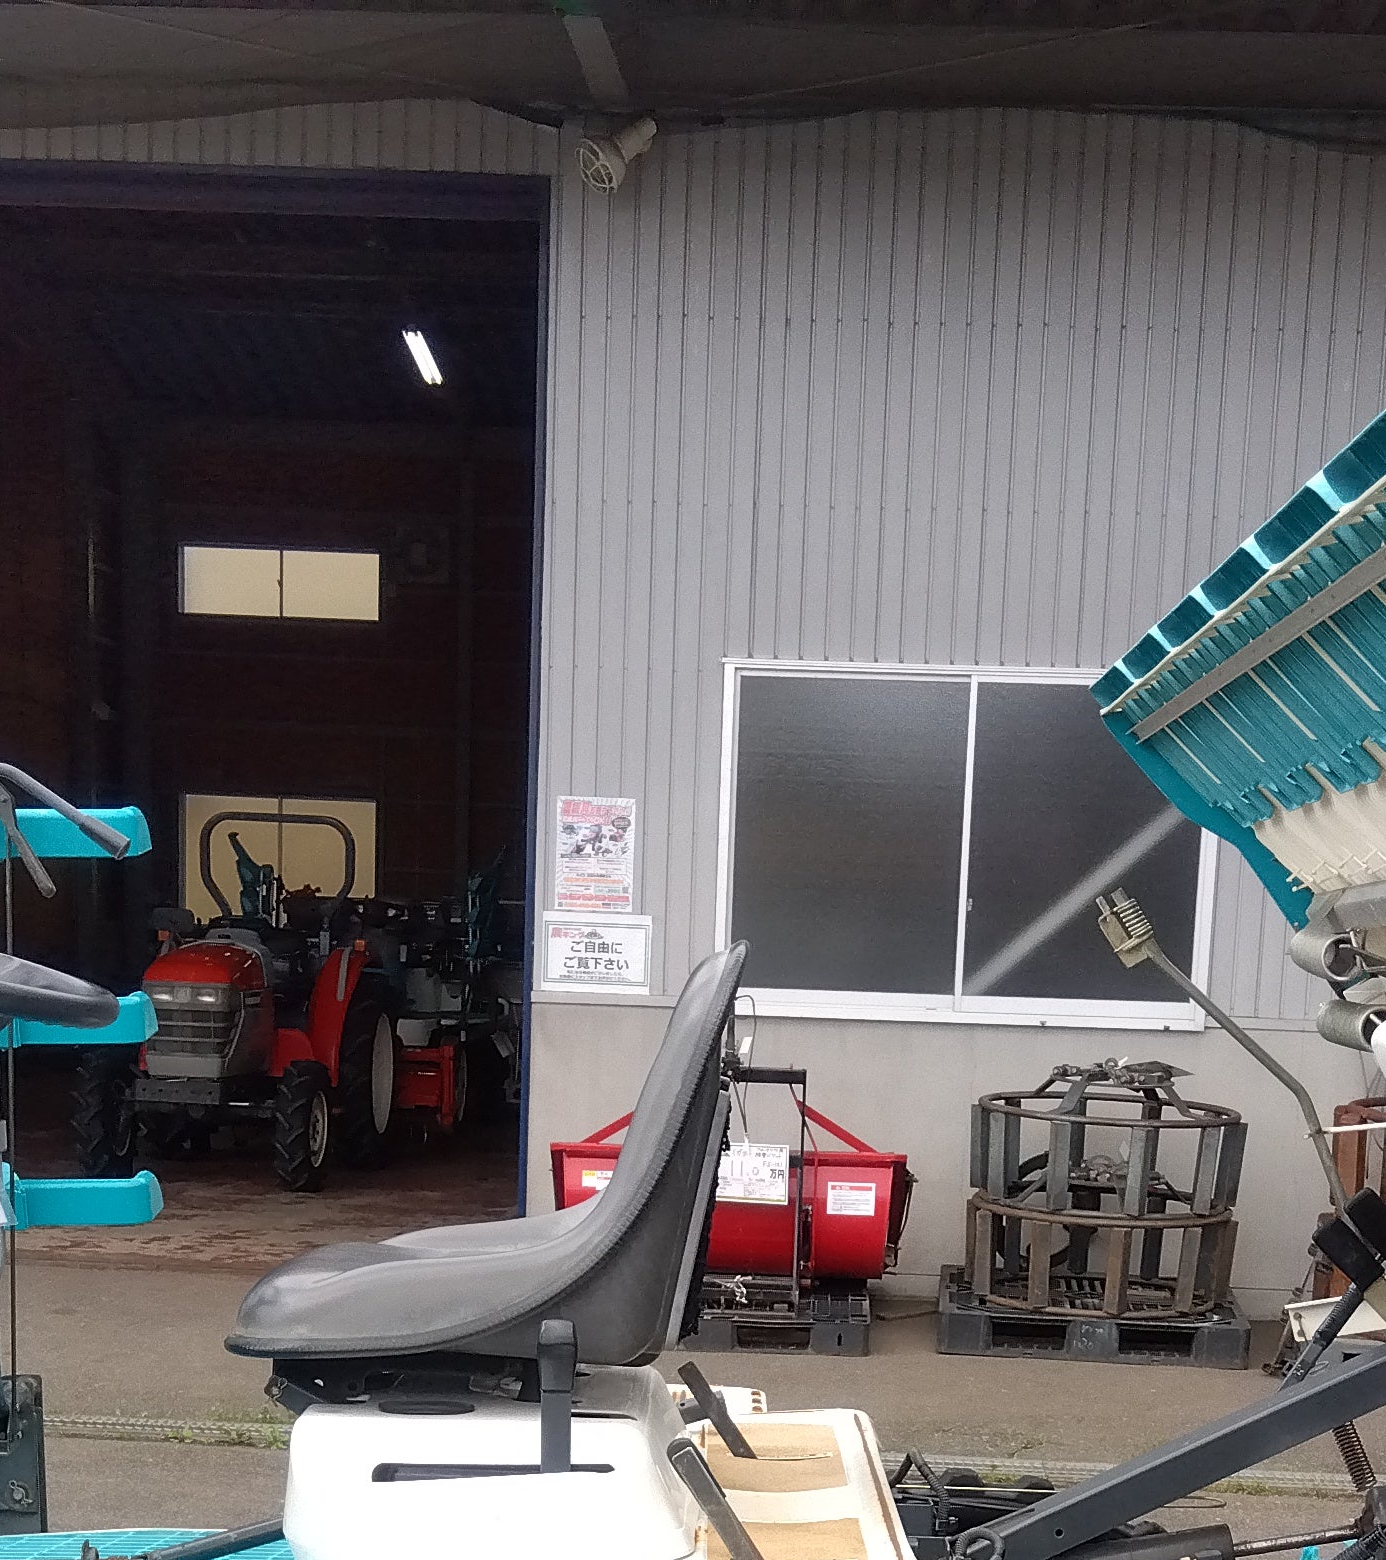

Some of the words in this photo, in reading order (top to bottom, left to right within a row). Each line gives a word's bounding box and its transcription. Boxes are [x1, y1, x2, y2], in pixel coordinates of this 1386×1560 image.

[570, 940, 623, 954] ご自由に
[563, 955, 630, 971] ご覧下さい
